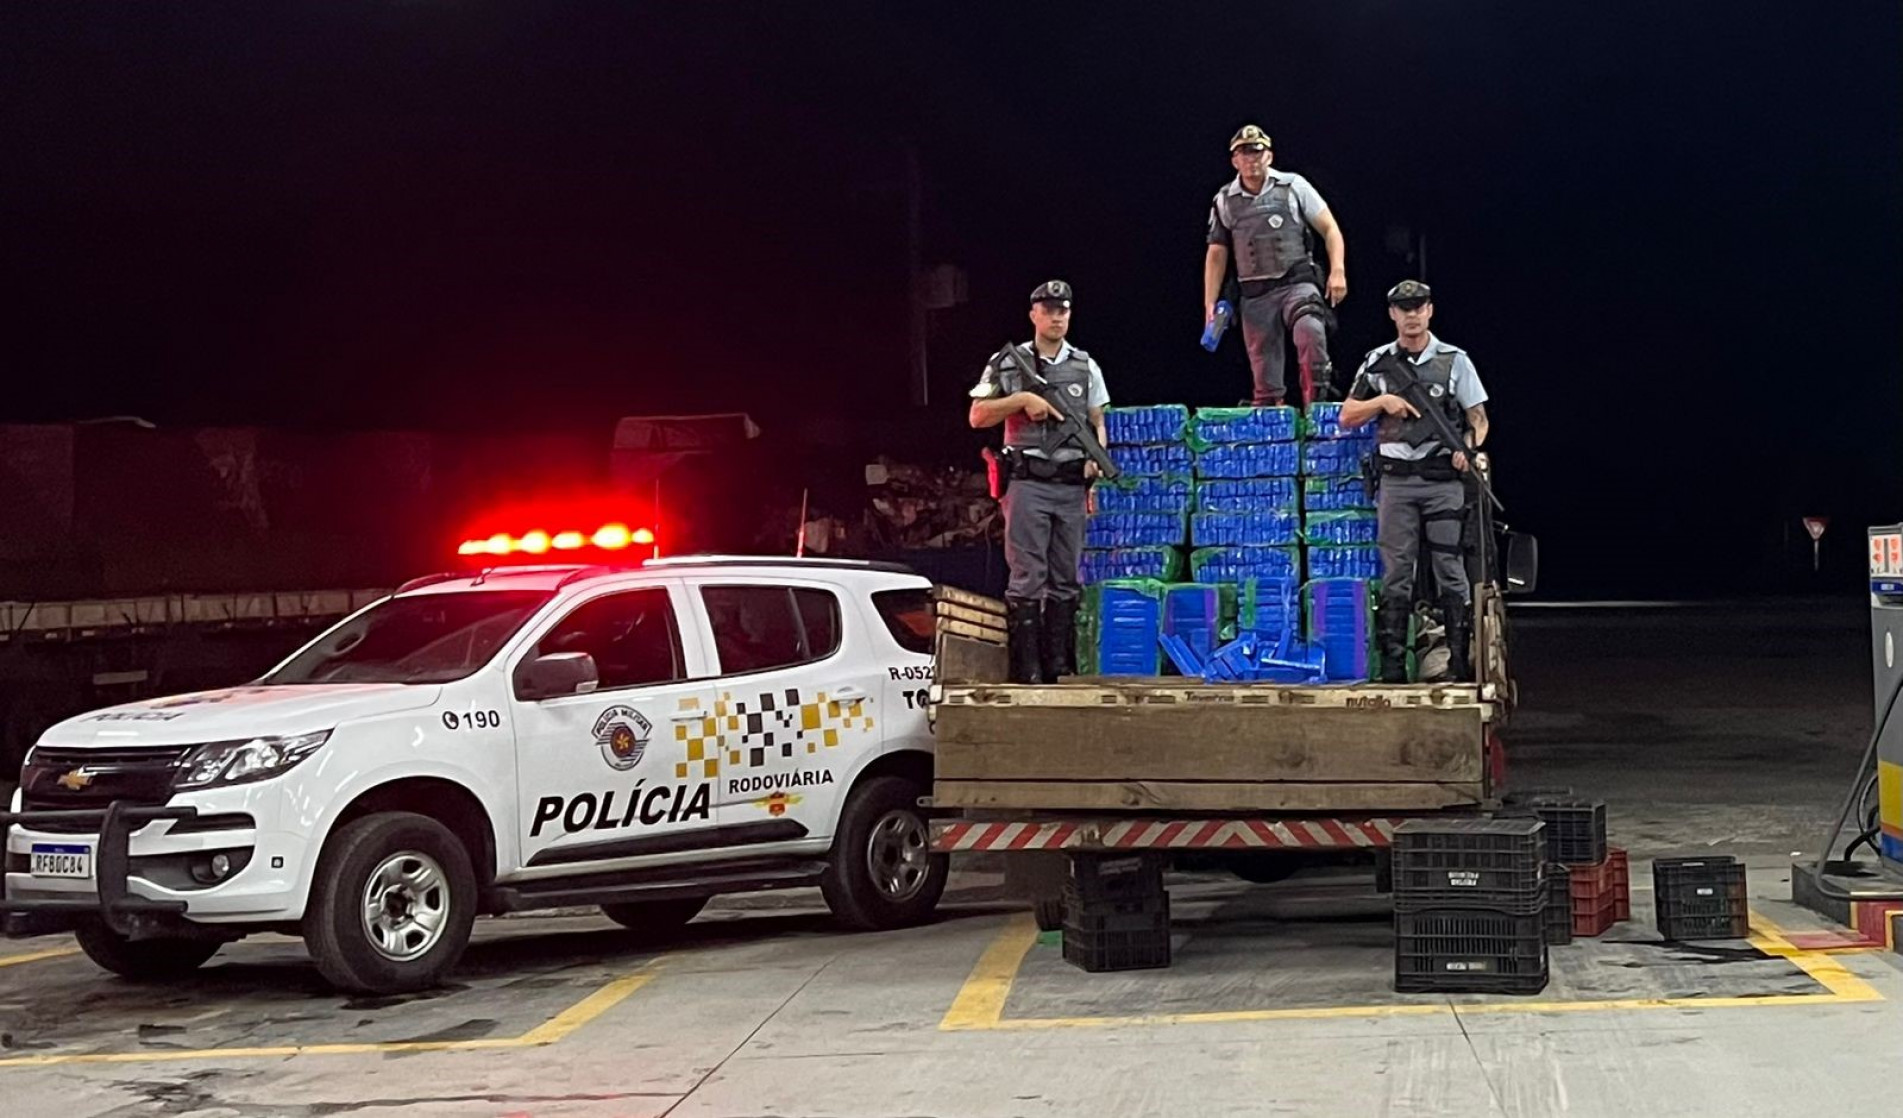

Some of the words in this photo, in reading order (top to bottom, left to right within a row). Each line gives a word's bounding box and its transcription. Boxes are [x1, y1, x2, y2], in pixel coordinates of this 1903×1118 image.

[888, 666, 936, 680] R-052
[463, 710, 500, 729] 190
[729, 768, 834, 794] RODOVIÁRIA
[529, 778, 711, 837] POLÍCIA
